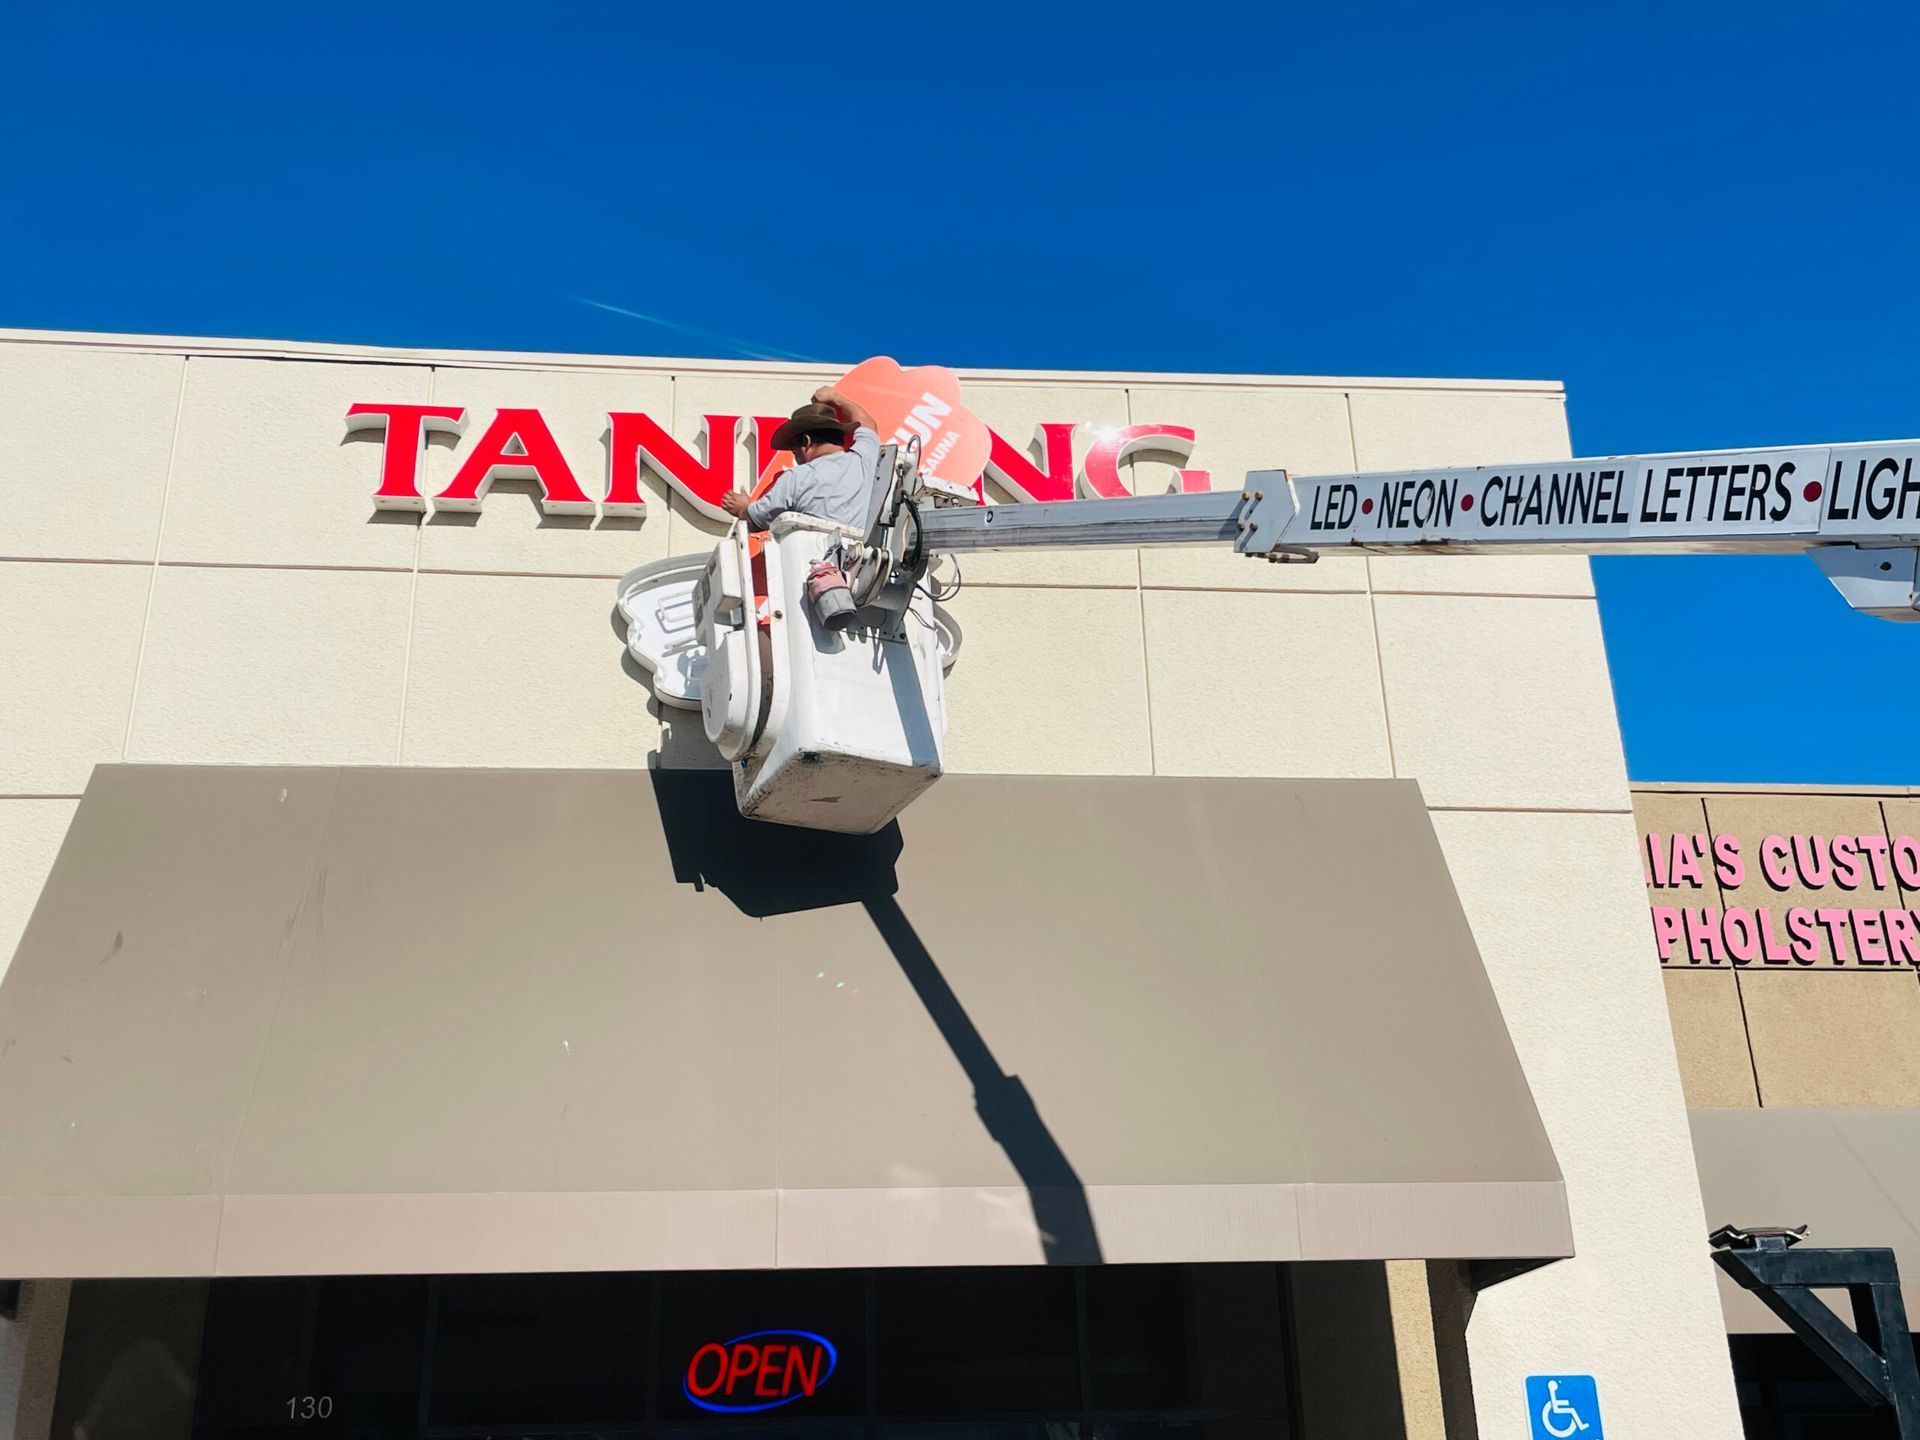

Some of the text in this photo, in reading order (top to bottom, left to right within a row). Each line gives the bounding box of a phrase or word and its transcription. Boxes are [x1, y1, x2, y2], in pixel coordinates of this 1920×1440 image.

[886, 391, 953, 449] UN
[344, 402, 1212, 514] TANNG
[1309, 456, 1920, 530] LED NEON CHANNEL LETTERS LIGH
[1640, 833, 1920, 892] IA'S CUSTO
[687, 1342, 823, 1397] OPEN
[286, 1396, 333, 1419] 130
